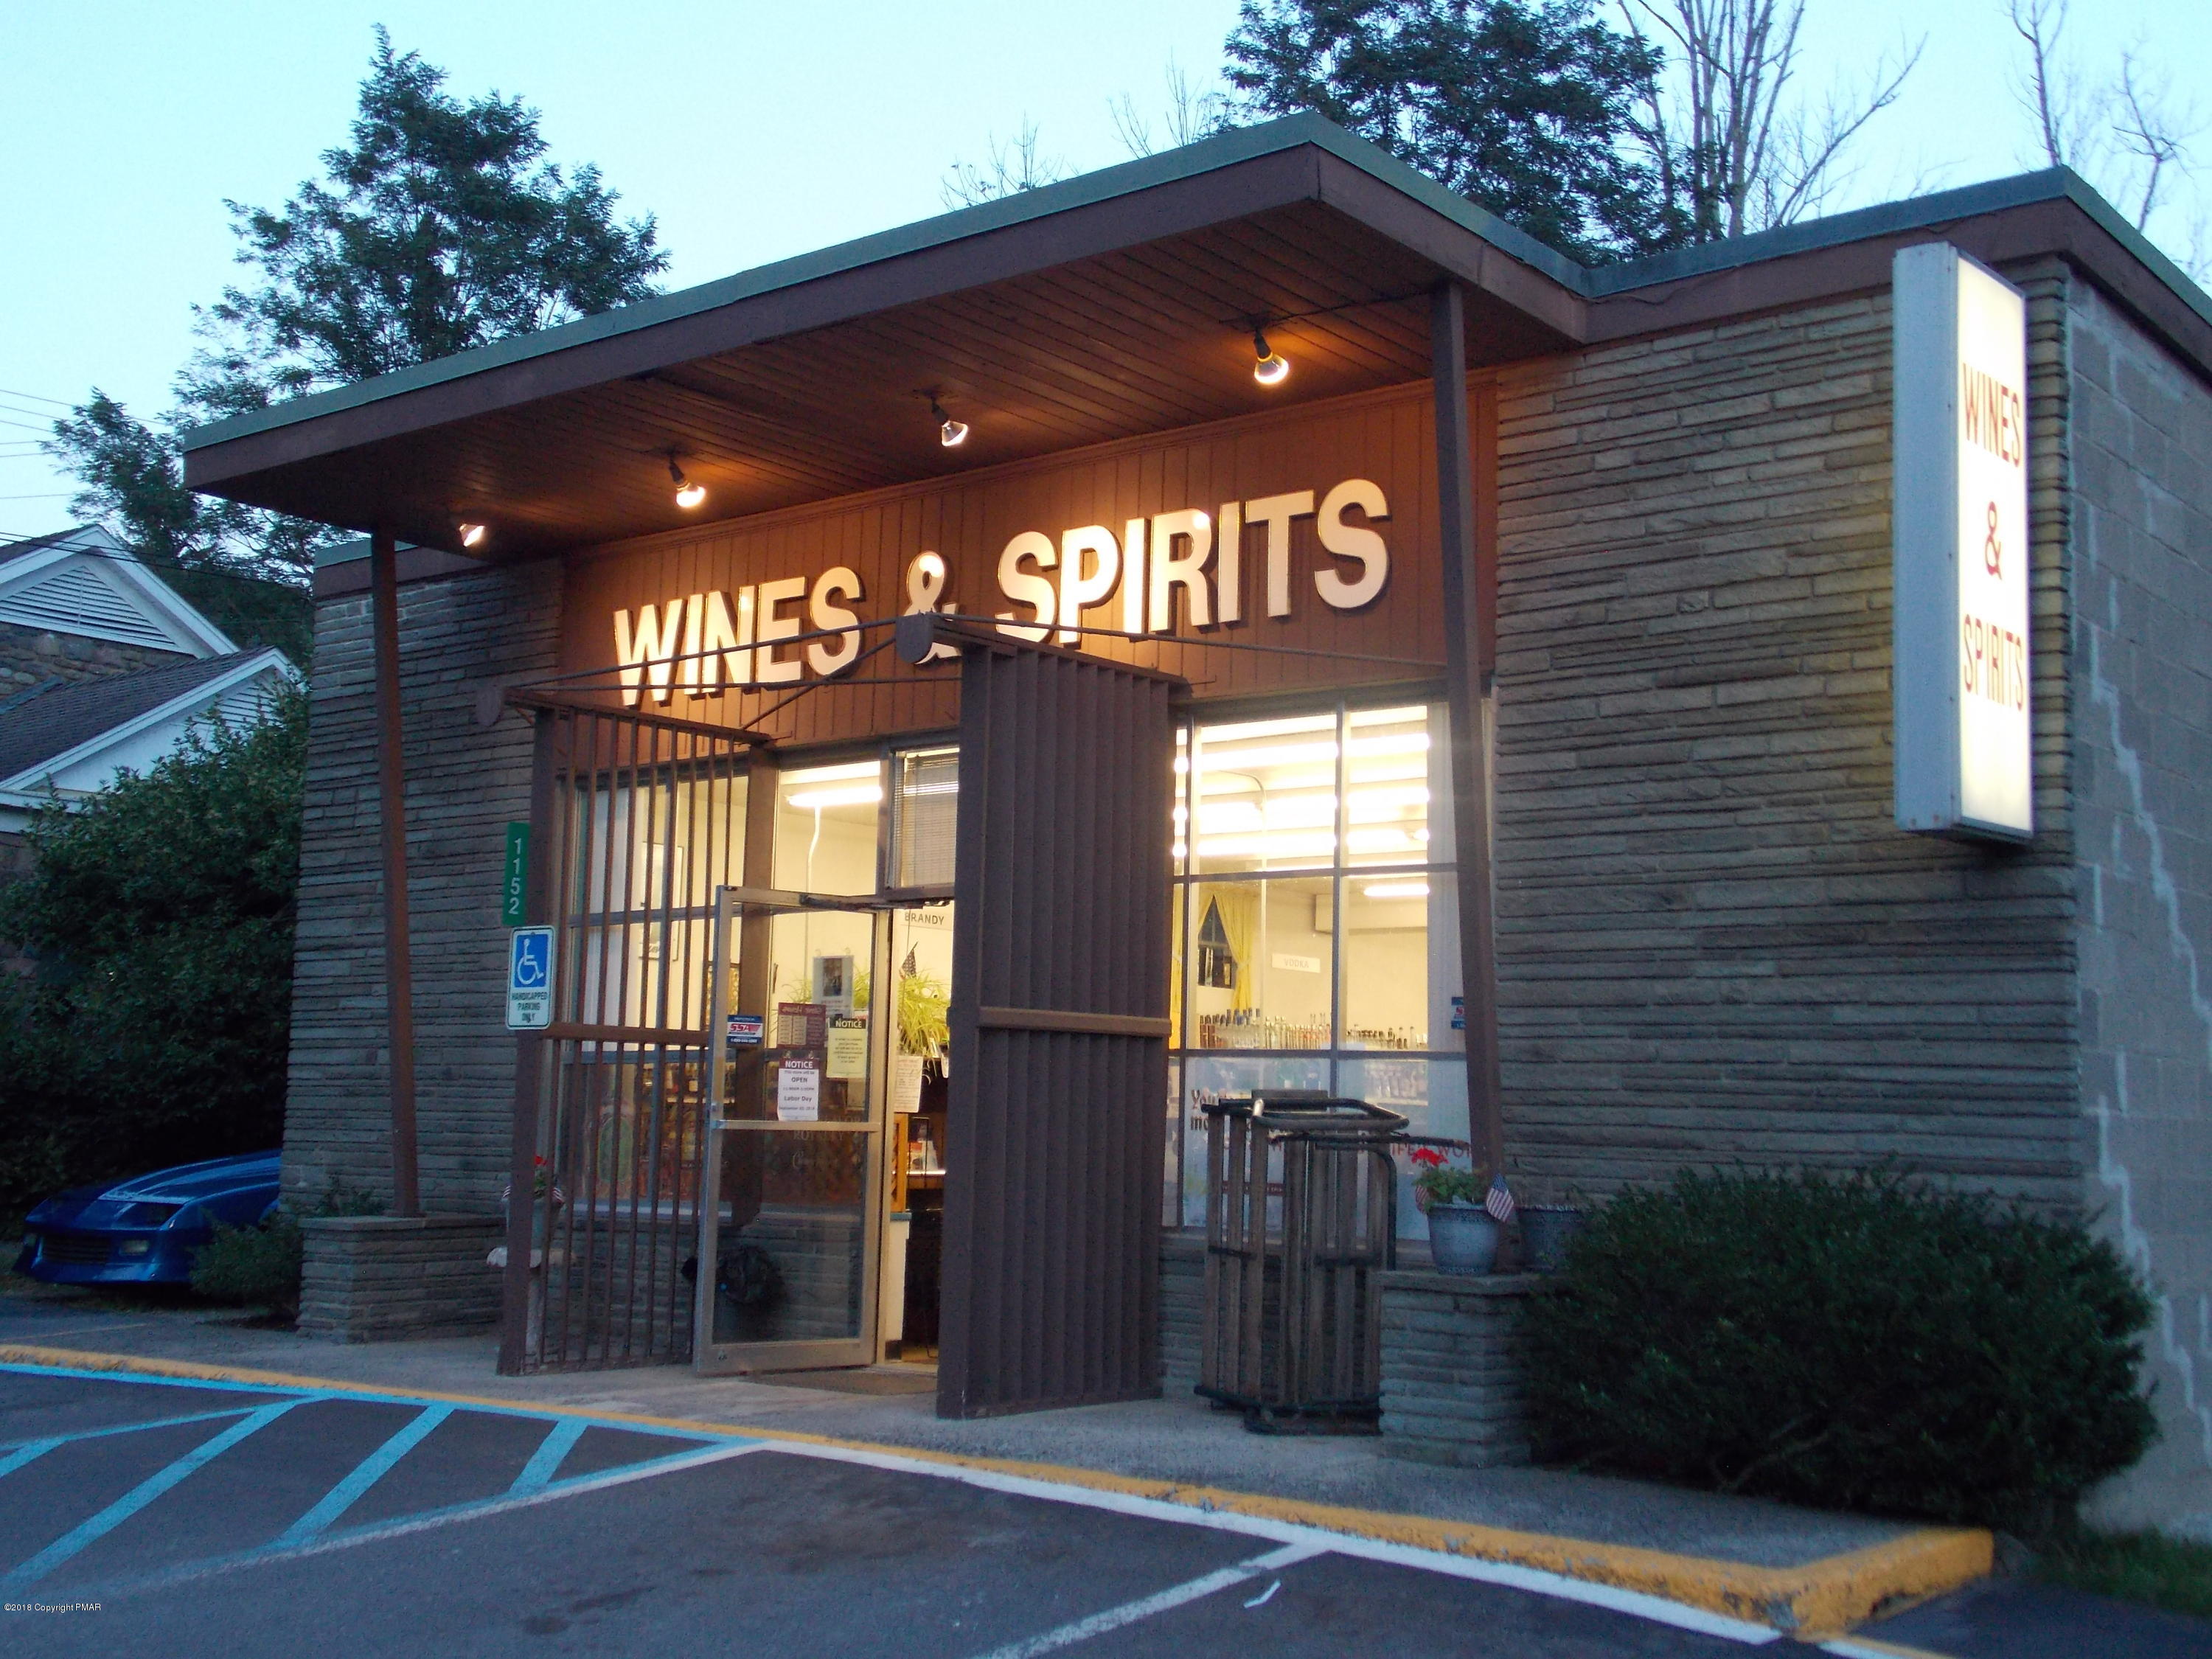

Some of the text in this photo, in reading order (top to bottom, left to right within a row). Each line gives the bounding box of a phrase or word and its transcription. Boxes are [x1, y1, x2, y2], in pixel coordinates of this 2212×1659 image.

[1962, 361, 2021, 468] WINES
[1984, 501, 2003, 581] &
[613, 478, 1392, 706] WINES & SPIRITS
[1964, 613, 2024, 713] SPIRITS
[508, 838, 522, 915] 1152
[904, 912, 945, 925] BRANDY
[1284, 958, 1310, 968] VODKA
[512, 992, 547, 1000] HANDICAPPED
[518, 1002, 540, 1010] PARKING
[835, 1020, 862, 1028] NOTICE
[785, 1060, 813, 1068] NOTICE
